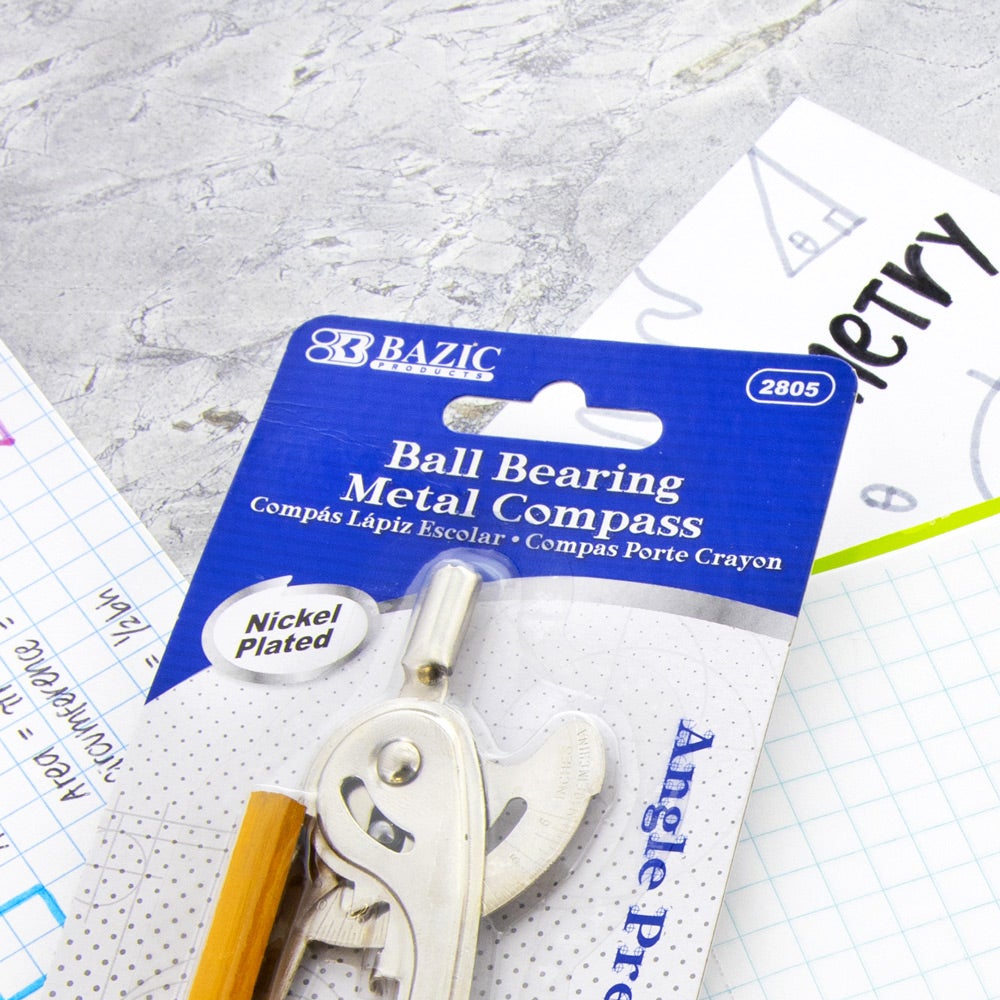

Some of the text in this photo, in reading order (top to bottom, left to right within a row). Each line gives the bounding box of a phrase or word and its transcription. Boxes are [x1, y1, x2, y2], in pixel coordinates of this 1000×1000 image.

[376, 335, 502, 372] BAZIC
[377, 362, 483, 379] PRODUCTS
[759, 378, 821, 399] 2805
[384, 439, 685, 504] Ball Bearing
[340, 472, 704, 541] Metal Compass
[250, 496, 783, 573] Compás Lápiz Escolar Compas Porte Crayon
[245, 603, 343, 634] Nickel
[235, 628, 334, 659] Plated
[32, 746, 91, 802] Area
[638, 718, 715, 891] Angle
